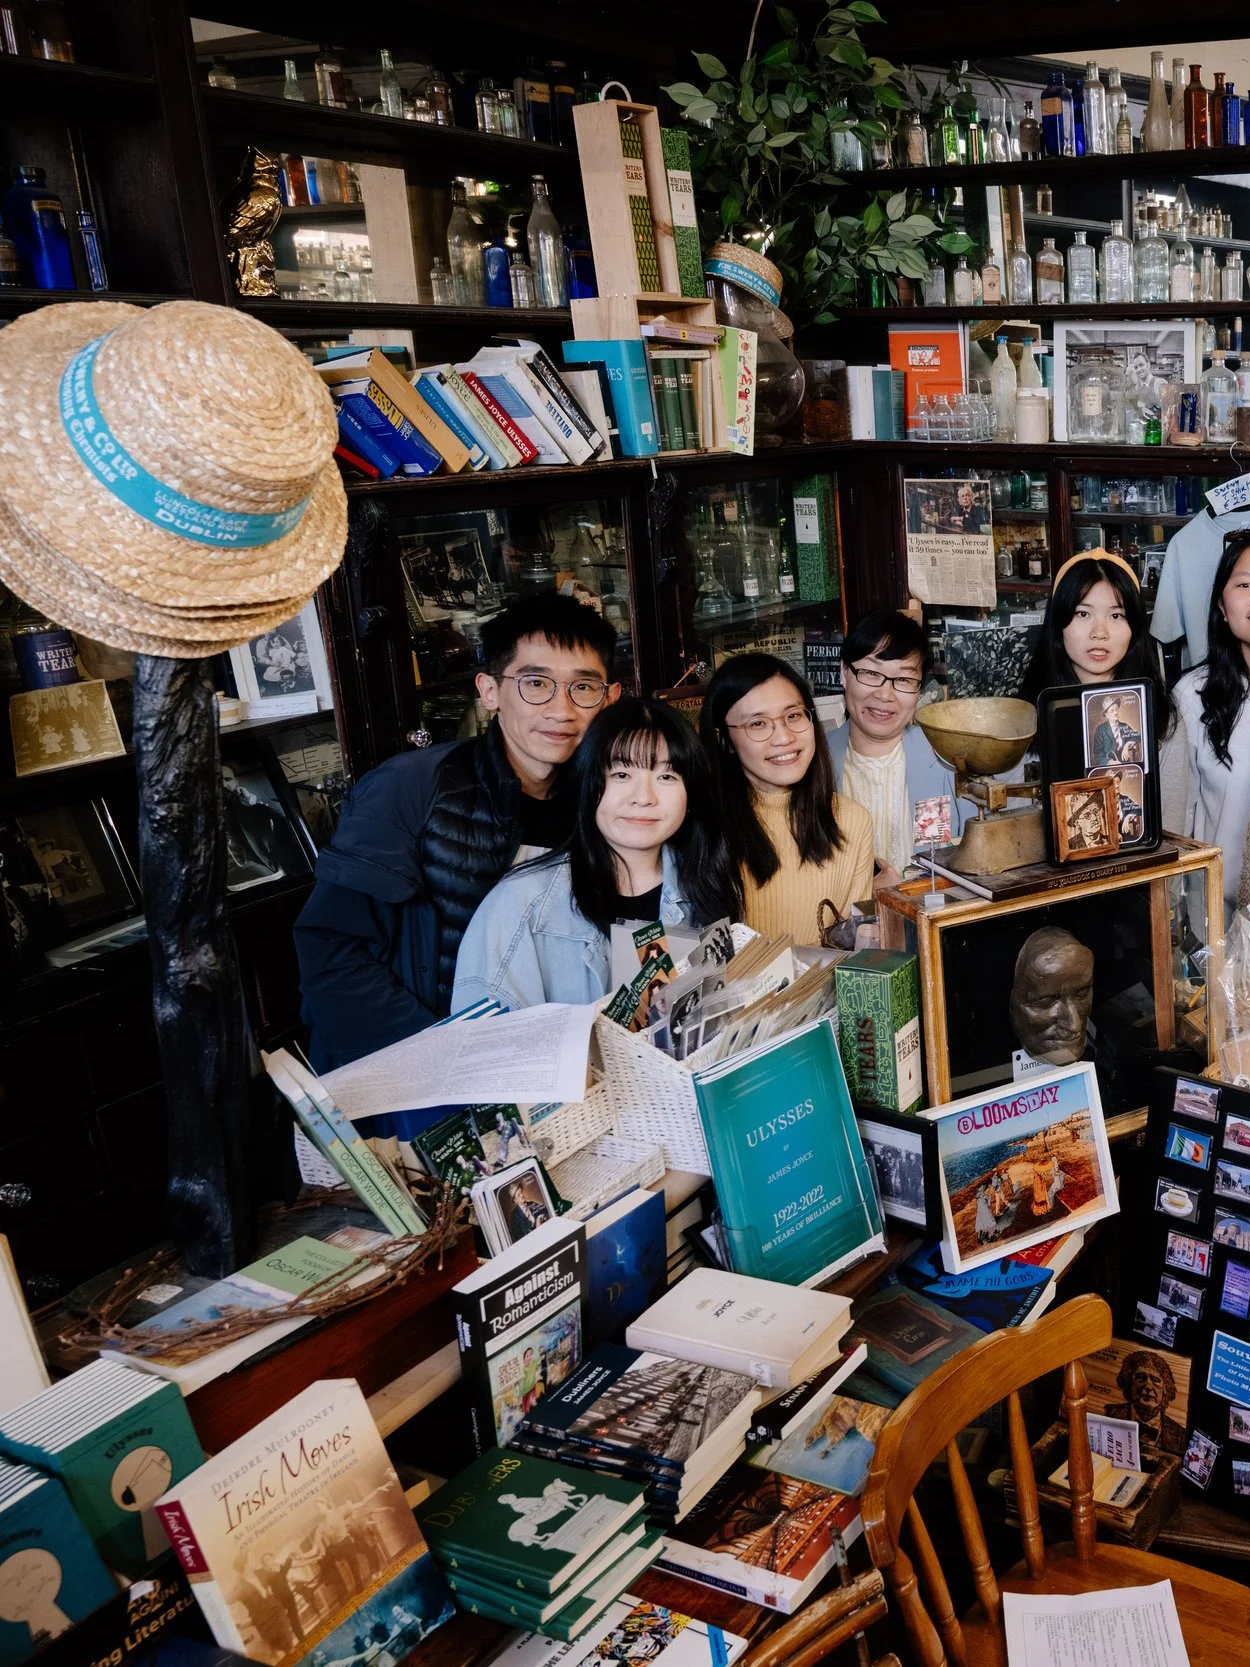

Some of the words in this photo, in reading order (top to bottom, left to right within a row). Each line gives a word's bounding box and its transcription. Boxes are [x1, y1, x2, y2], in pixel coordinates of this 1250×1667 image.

[670, 184, 692, 193] TEARS
[468, 379, 491, 406] JAMES
[488, 402, 509, 428] JOYCE
[506, 426, 532, 459] ULYSSES
[1214, 480, 1239, 497] SWENY
[155, 509, 238, 542] DUBLIN
[795, 508, 817, 517] TEARS
[925, 546, 943, 554] times
[951, 548, 963, 556] you
[973, 539, 988, 547] read
[754, 637, 797, 648] REPUBLIC
[897, 1037, 920, 1062] TEARS
[1020, 1060, 1045, 1071] Jame
[746, 1098, 814, 1148] ULYSSES
[957, 1085, 1060, 1135] BLOOMSDAY
[339, 1152, 365, 1183] OSCAR
[362, 1180, 387, 1212] WILDE
[361, 1151, 387, 1183] OSCAR
[385, 1179, 408, 1210] WILDE
[767, 1165, 792, 1184] JAMES
[792, 1150, 814, 1169] JOYCE
[772, 1227, 796, 1246] YEARS
[796, 1220, 804, 1230] OF
[805, 1195, 843, 1225] BRILLIANCE
[773, 1184, 825, 1228] 1922-2022
[266, 1258, 301, 1278] OSCAR
[504, 1260, 560, 1309] Against
[945, 1277, 981, 1288] BLAME
[984, 1276, 1002, 1287] THE
[1005, 1271, 1034, 1286] GODS
[490, 1272, 574, 1334] Romanticism
[713, 1299, 736, 1318] JOYCE
[1214, 1372, 1240, 1386] Photo
[1216, 1355, 1230, 1364] The
[1231, 1360, 1250, 1372] Little
[562, 1366, 603, 1403] Dubliners
[573, 1386, 593, 1405] JAMES
[591, 1369, 612, 1389] JOYCE
[1088, 1382, 1112, 1394] Murphy
[211, 1454, 262, 1495] DEIRDRE
[264, 1403, 336, 1456] MULROONEY
[218, 1468, 276, 1534] Irish
[280, 1425, 352, 1494] Moves
[288, 1487, 320, 1511] THEATRE
[330, 1458, 359, 1480] IRELAND
[290, 1475, 320, 1497] HISTORY
[332, 1449, 356, 1468] DANCE
[164, 1510, 181, 1537] Irish
[174, 1531, 197, 1568] Moves
[123, 1594, 196, 1652] Literatu
